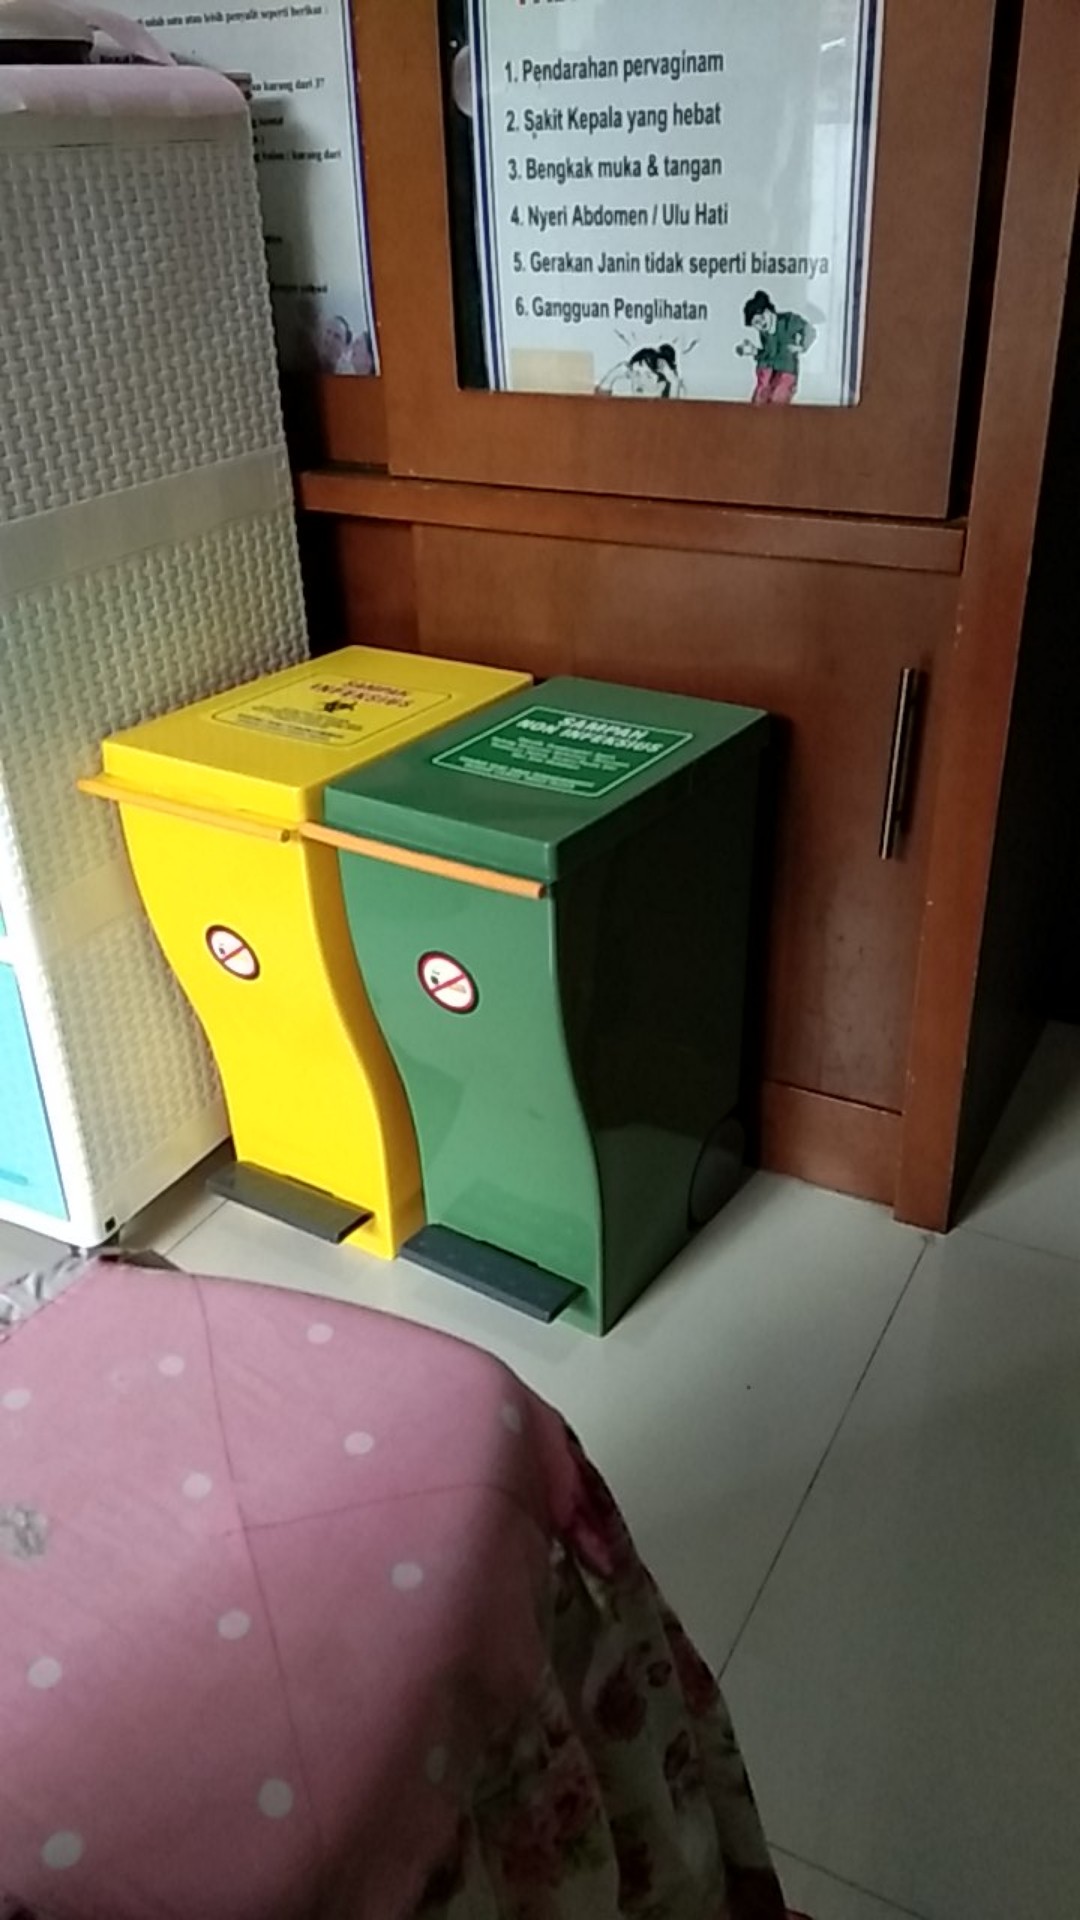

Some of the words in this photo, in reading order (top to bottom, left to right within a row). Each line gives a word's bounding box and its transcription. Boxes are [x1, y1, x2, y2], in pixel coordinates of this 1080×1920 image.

[505, 62, 518, 82] 1.
[523, 58, 617, 83] Pendarahan
[623, 51, 723, 82] pervaginam
[506, 112, 519, 131] 2.
[524, 109, 563, 131] Sakit
[568, 106, 623, 135] Kepala
[627, 110, 668, 133] yang
[673, 103, 721, 126] hebat
[508, 159, 522, 180] 3.
[526, 158, 593, 184] Bengkak
[598, 156, 642, 177] muka
[647, 157, 659, 176] &
[664, 156, 722, 181] tangan
[511, 208, 524, 227] 4.
[528, 206, 568, 231] Nyeri
[572, 205, 648, 226] Abdomen
[662, 204, 690, 226] Ulu
[695, 203, 728, 225] Hati
[514, 254, 527, 274] 5.
[530, 251, 593, 274] Gerakan
[597, 253, 640, 274] Janin
[644, 252, 684, 274] tidak
[689, 252, 746, 279] seperti
[751, 252, 828, 279] biasanya
[515, 299, 529, 318] 6.
[532, 298, 609, 323] Gangguan
[615, 299, 707, 324] Penglihatan
[559, 729, 664, 753] INFEKSIUS
